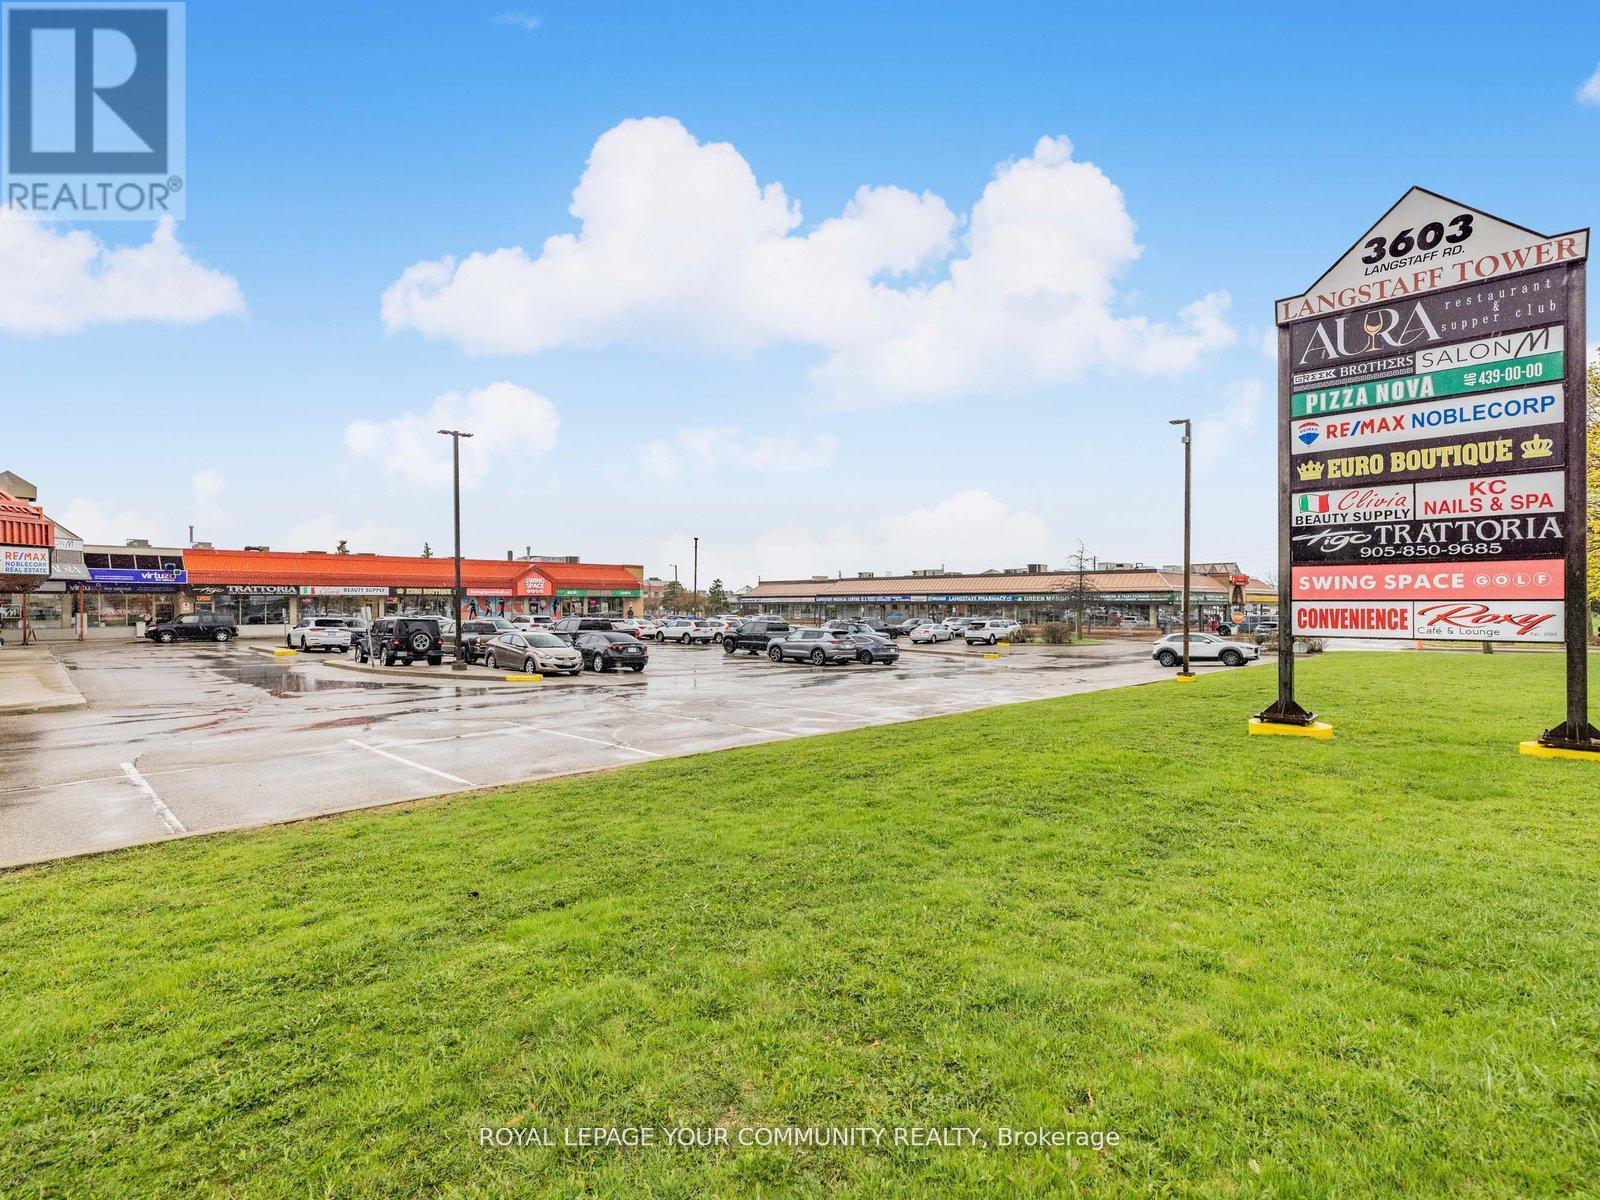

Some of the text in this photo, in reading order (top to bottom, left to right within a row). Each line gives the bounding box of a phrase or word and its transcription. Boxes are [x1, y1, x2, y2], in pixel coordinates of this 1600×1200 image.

[1361, 213, 1474, 265] 3603
[1364, 244, 1466, 276] LANGSTAFF RD.
[1283, 237, 1579, 321] LANGSTAFF TOWER
[1444, 278, 1553, 311] restaurant
[1441, 299, 1557, 332] supper club
[1299, 301, 1442, 365] AURA
[1422, 338, 1511, 368] SALON
[1479, 362, 1543, 386] 439-00-00
[1305, 375, 1436, 414] PIZZA NOVA
[1326, 394, 1556, 439] RE/MAX NOBLECORP
[1327, 438, 1513, 480] EURO BOUTIQUE
[1337, 489, 1407, 512] Clivia
[1469, 479, 1507, 496] KC
[1295, 508, 1411, 526] BEAUTY SUPPLY
[1424, 492, 1554, 515] NAILS & SPA
[1373, 516, 1565, 545] TRATTORIA
[5, 551, 47, 561] RE/MAX
[1360, 541, 1503, 558] 905-850-9685
[226, 585, 298, 593] TRATTORIA
[1298, 575, 1377, 591] SWING
[1383, 573, 1465, 590] SPACE
[1297, 607, 1409, 631] CONVENIENCE
[1418, 603, 1557, 636] Roxy
[1459, 628, 1501, 638] Lounge
